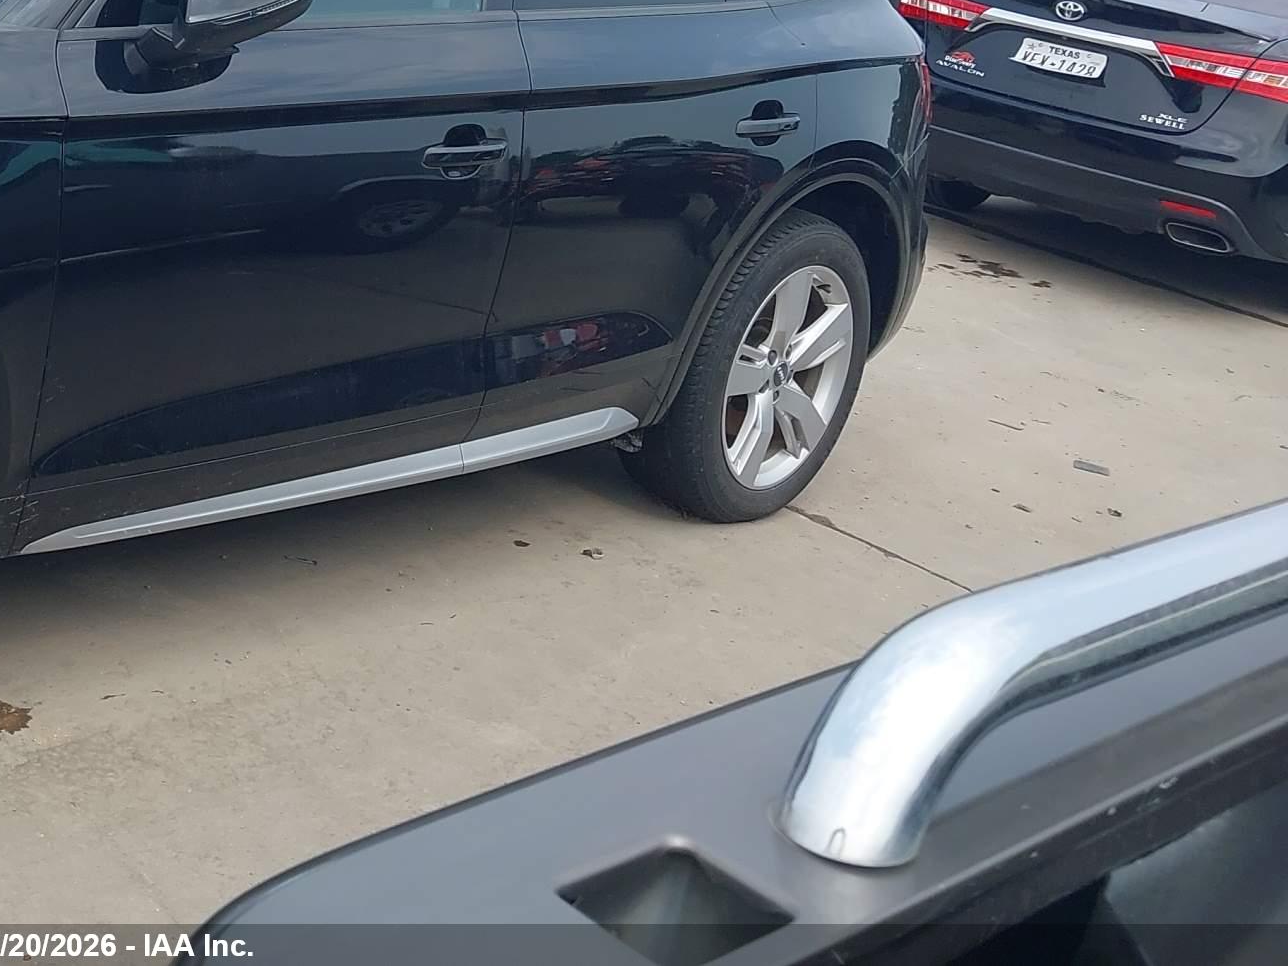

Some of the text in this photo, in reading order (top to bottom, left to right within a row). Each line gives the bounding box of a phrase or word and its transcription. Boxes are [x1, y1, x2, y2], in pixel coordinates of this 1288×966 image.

[1048, 45, 1081, 60] TEXAS
[935, 59, 985, 77] AVALON
[1139, 114, 1185, 130] SEWELL
